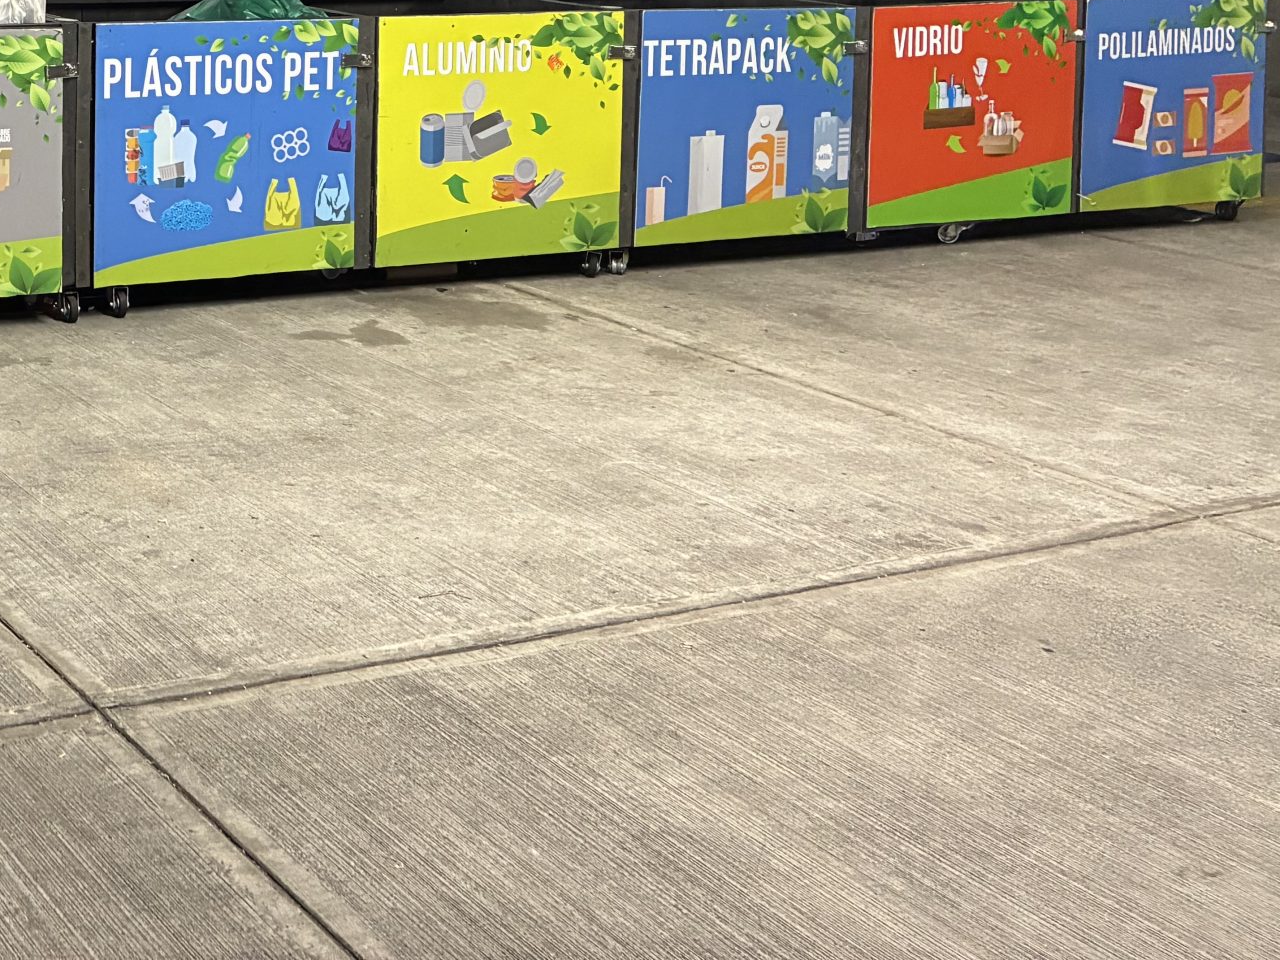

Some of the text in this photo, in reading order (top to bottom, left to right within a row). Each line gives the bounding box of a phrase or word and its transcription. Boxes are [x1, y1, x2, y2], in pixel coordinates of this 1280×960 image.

[402, 40, 532, 77] ALUMINIO
[643, 37, 792, 77] TETRAPACK
[893, 25, 963, 58] VIDRIO
[1098, 25, 1236, 60] POLILAMINADOS
[103, 48, 340, 100] PLÁSTICOS PET
